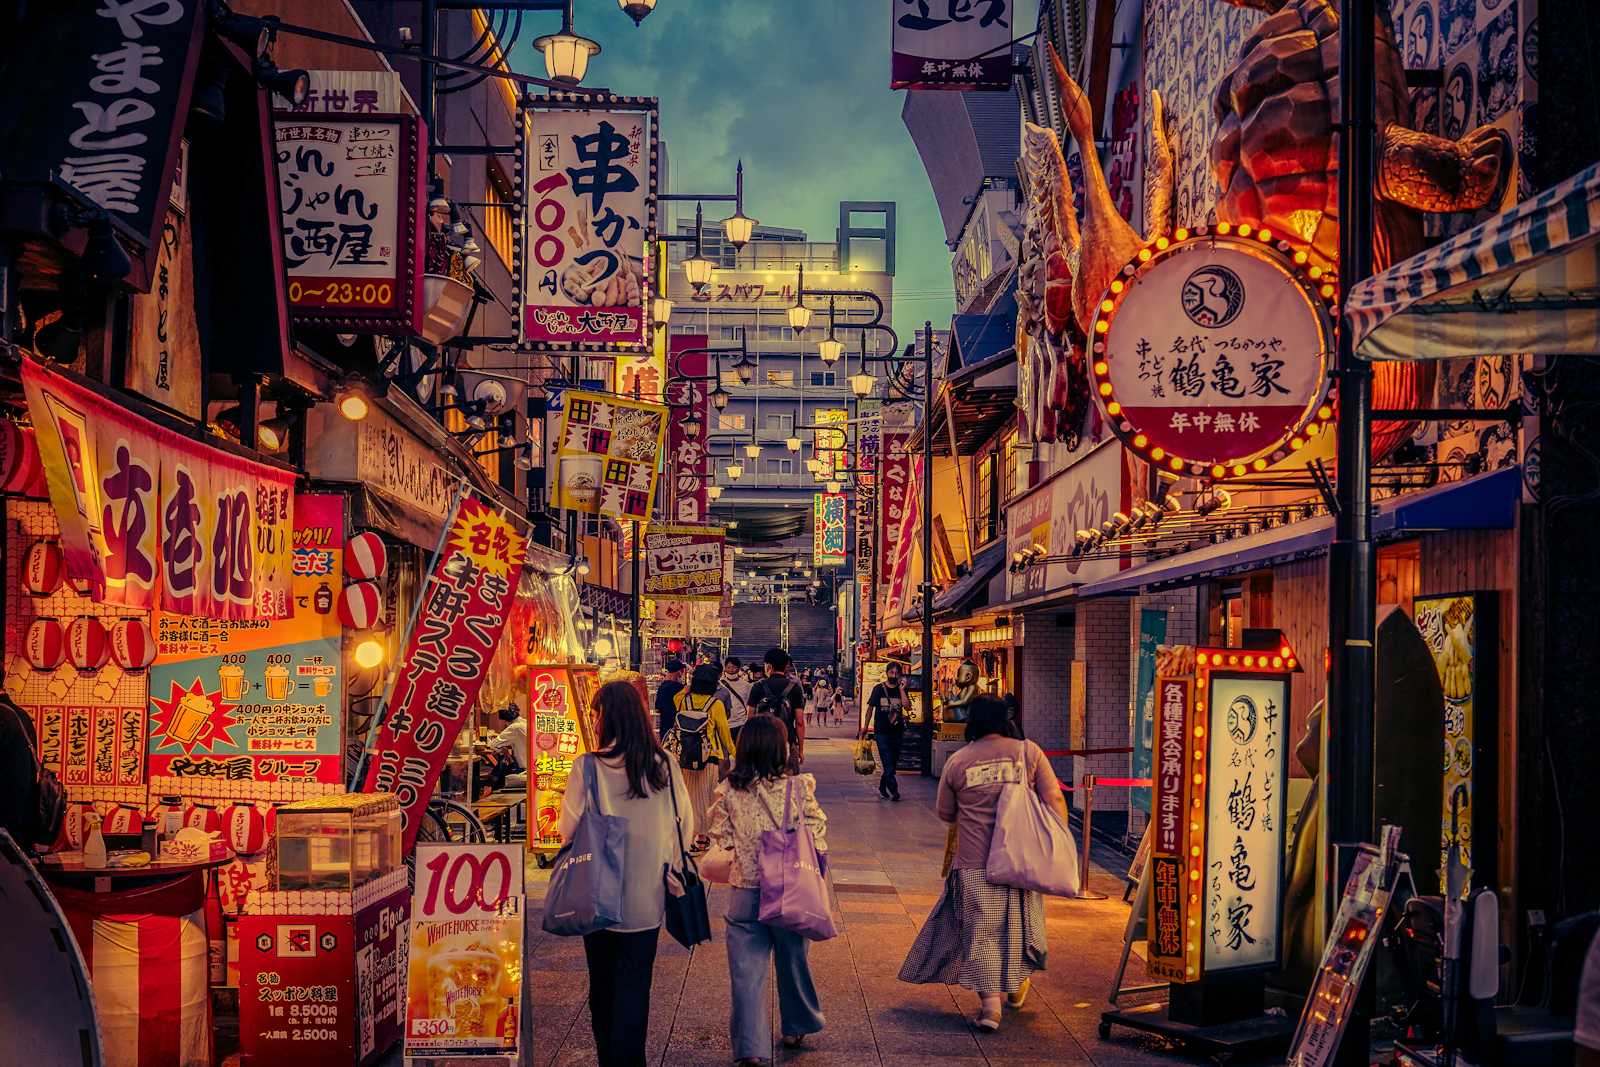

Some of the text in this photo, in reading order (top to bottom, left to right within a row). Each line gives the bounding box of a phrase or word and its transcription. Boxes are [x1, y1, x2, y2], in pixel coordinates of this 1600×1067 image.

[921, 61, 984, 78] 年中無休
[349, 126, 390, 139] 串かつ
[346, 144, 395, 159] どて焼き
[540, 137, 557, 168] 全て
[357, 161, 386, 174] 一品
[565, 120, 640, 290] 串かつ
[1169, 335, 1284, 353] 名代 つるかめや
[1135, 337, 1152, 382] 串かつ
[1150, 354, 1166, 399] どて焼
[1167, 352, 1292, 399] 鶴亀家
[1168, 411, 1261, 434] 年中無休
[886, 439, 912, 582] ふぐなら日本
[468, 521, 511, 563] 名物
[32, 549, 42, 583] キリンビール
[655, 549, 700, 571] ビリーズ
[645, 570, 721, 592] 大阪みやげ
[31, 626, 40, 661] キリンビール
[74, 623, 83, 659] キリンビール
[116, 626, 127, 661] キリンビール
[158, 630, 230, 642] お客様に酒一合
[158, 643, 219, 655] 無料サービス
[221, 654, 323, 665] 400 400 一杯
[298, 666, 335, 675] 無料サービス
[236, 716, 332, 725] お一人で二杯お飲みの方に
[247, 725, 318, 737] 小ジョッキ一杯
[536, 715, 576, 732] 時間営業
[1262, 698, 1278, 762] 串かつ
[69, 716, 88, 757] ホルモン
[250, 739, 315, 750] 無料サービス
[259, 759, 321, 774] グループ
[1227, 748, 1257, 768] 名代
[67, 769, 87, 783] 550
[1260, 771, 1275, 832] どて焼
[235, 811, 246, 848] キリンビール
[1225, 771, 1257, 951] 鶴亀家
[422, 850, 513, 916] 100
[1156, 859, 1181, 955] 年中無休
[1210, 861, 1222, 945] つるかめや
[427, 920, 453, 947] WHITE
[453, 919, 479, 935] HORSE
[258, 986, 338, 1002] スッポン料理
[445, 987, 465, 1008] WHITE
[290, 1004, 338, 1017] 8,500円
[292, 1029, 338, 1041] 2,500円
